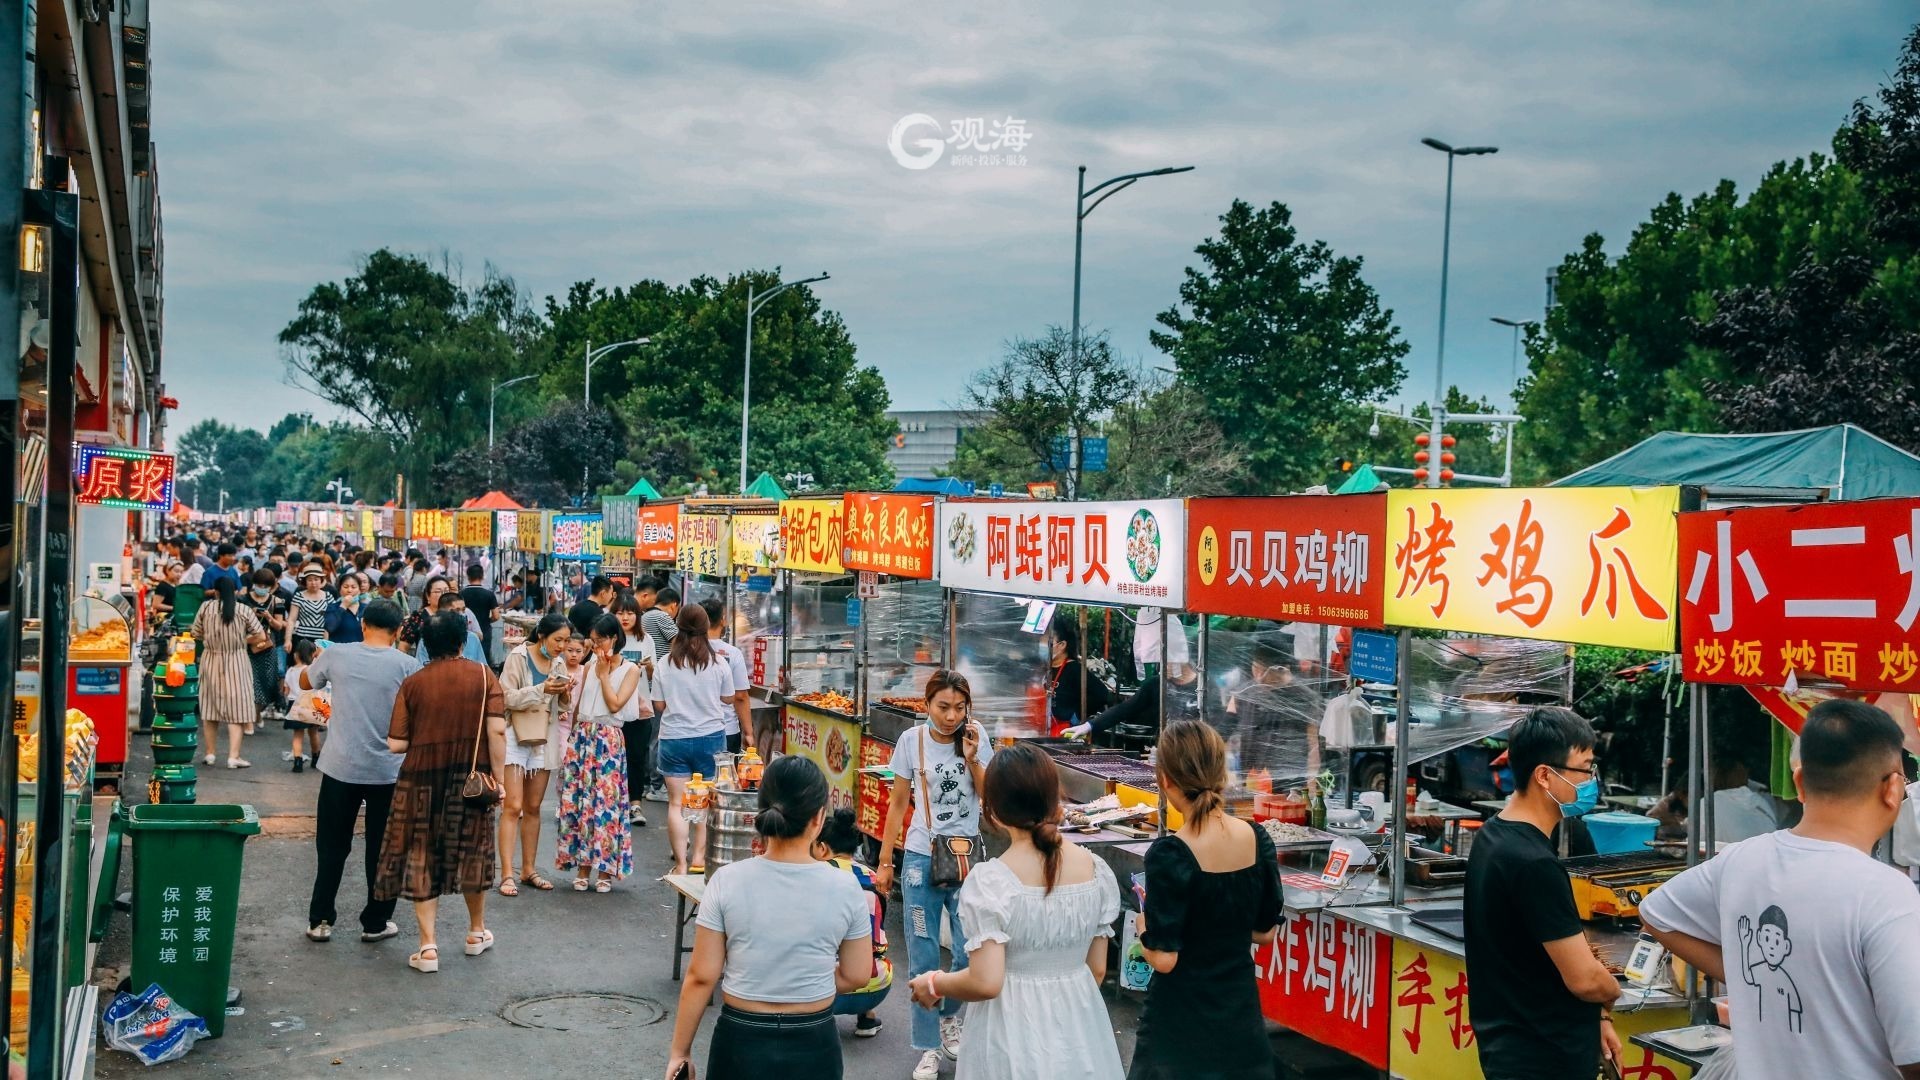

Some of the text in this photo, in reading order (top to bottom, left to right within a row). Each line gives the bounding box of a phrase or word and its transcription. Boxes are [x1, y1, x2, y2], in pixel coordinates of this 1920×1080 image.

[84, 456, 166, 502] 原浆
[680, 516, 718, 547] 炸鸡柳
[789, 505, 842, 566] 锅包肉
[843, 500, 930, 550] 奥尔良风味
[987, 513, 1111, 585] 阿蚝阿贝
[1203, 535, 1213, 575] 阿福
[1226, 528, 1369, 595] 贝贝鸡柳
[1395, 499, 1668, 629] 烤鸡爪
[1694, 639, 1764, 677] 炒饭
[1780, 640, 1858, 681] 炒面
[159, 886, 181, 964] 保护环境
[193, 886, 213, 963] 爱我家园
[1252, 912, 1377, 1029] 炸鸡柳
